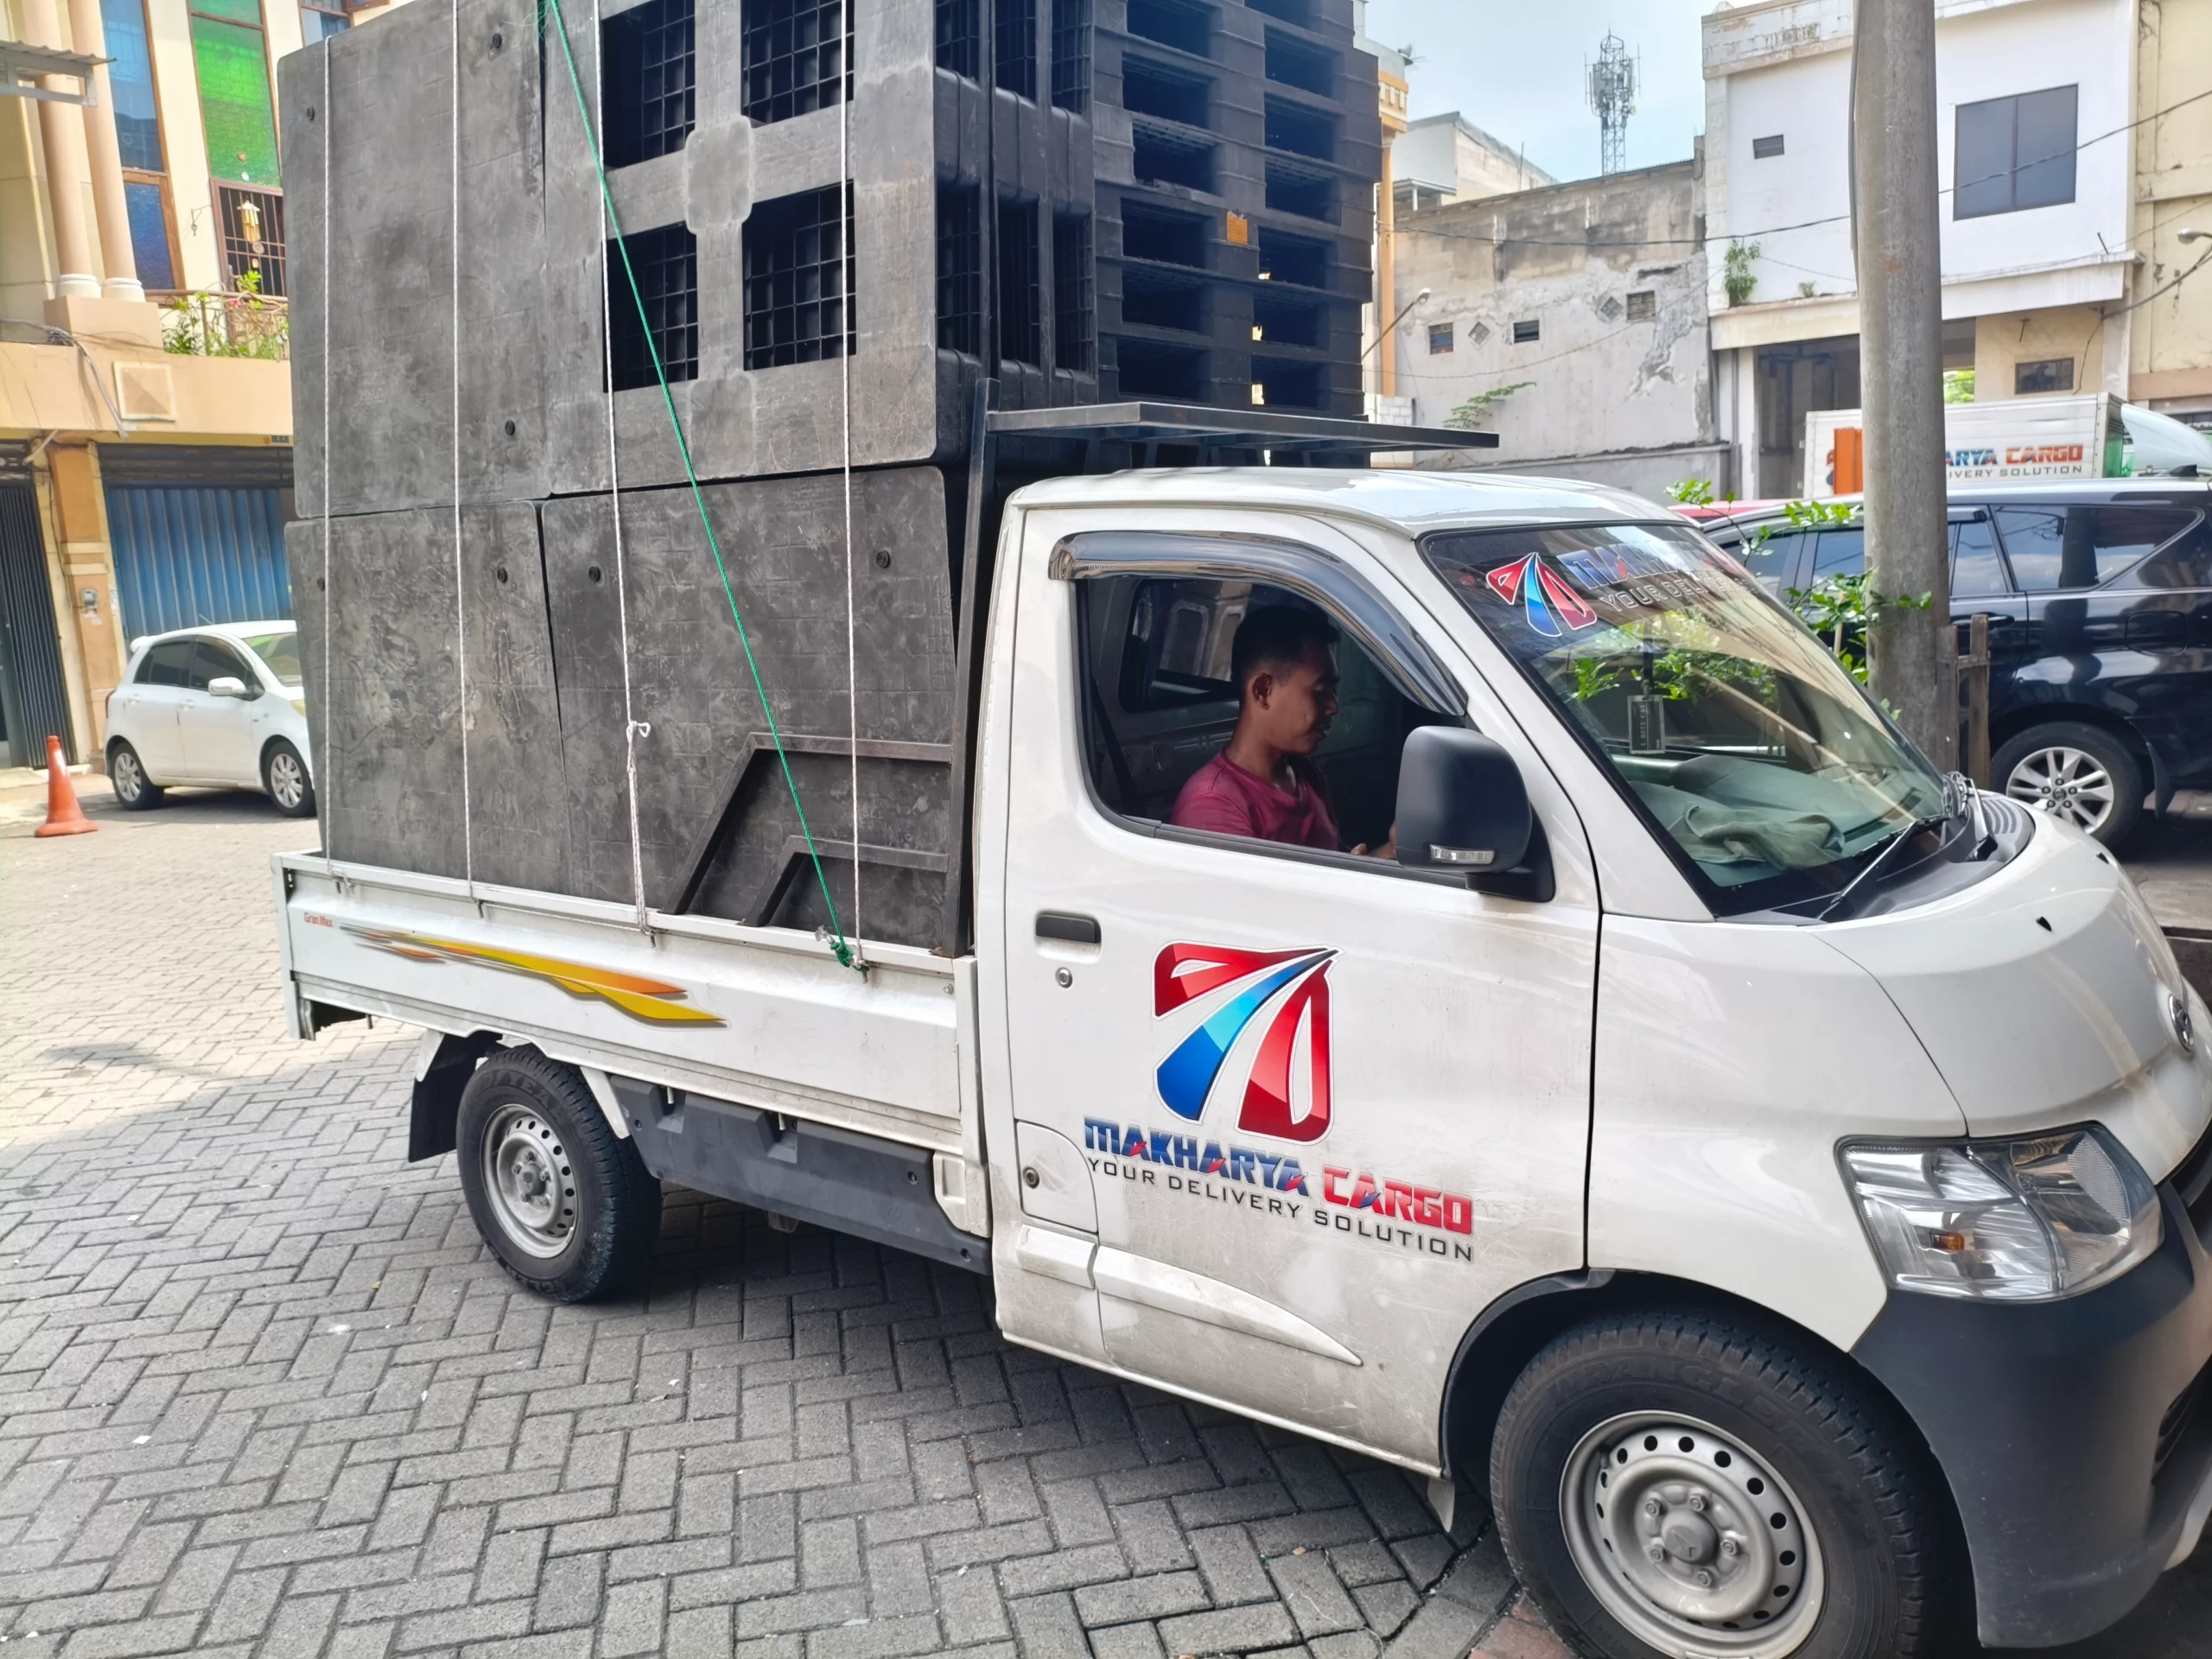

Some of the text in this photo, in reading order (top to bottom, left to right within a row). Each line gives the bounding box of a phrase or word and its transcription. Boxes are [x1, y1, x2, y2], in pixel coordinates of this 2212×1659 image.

[2005, 444, 2084, 465] CARGO
[1999, 466, 2082, 477] SOLUTION
[1599, 584, 1669, 613] YOUR
[304, 912, 334, 928] Gran Max
[1084, 1116, 1473, 1236] MAKHARYA CARGO
[1086, 1156, 1472, 1262] YOUR DELIVERY SOLUTION
